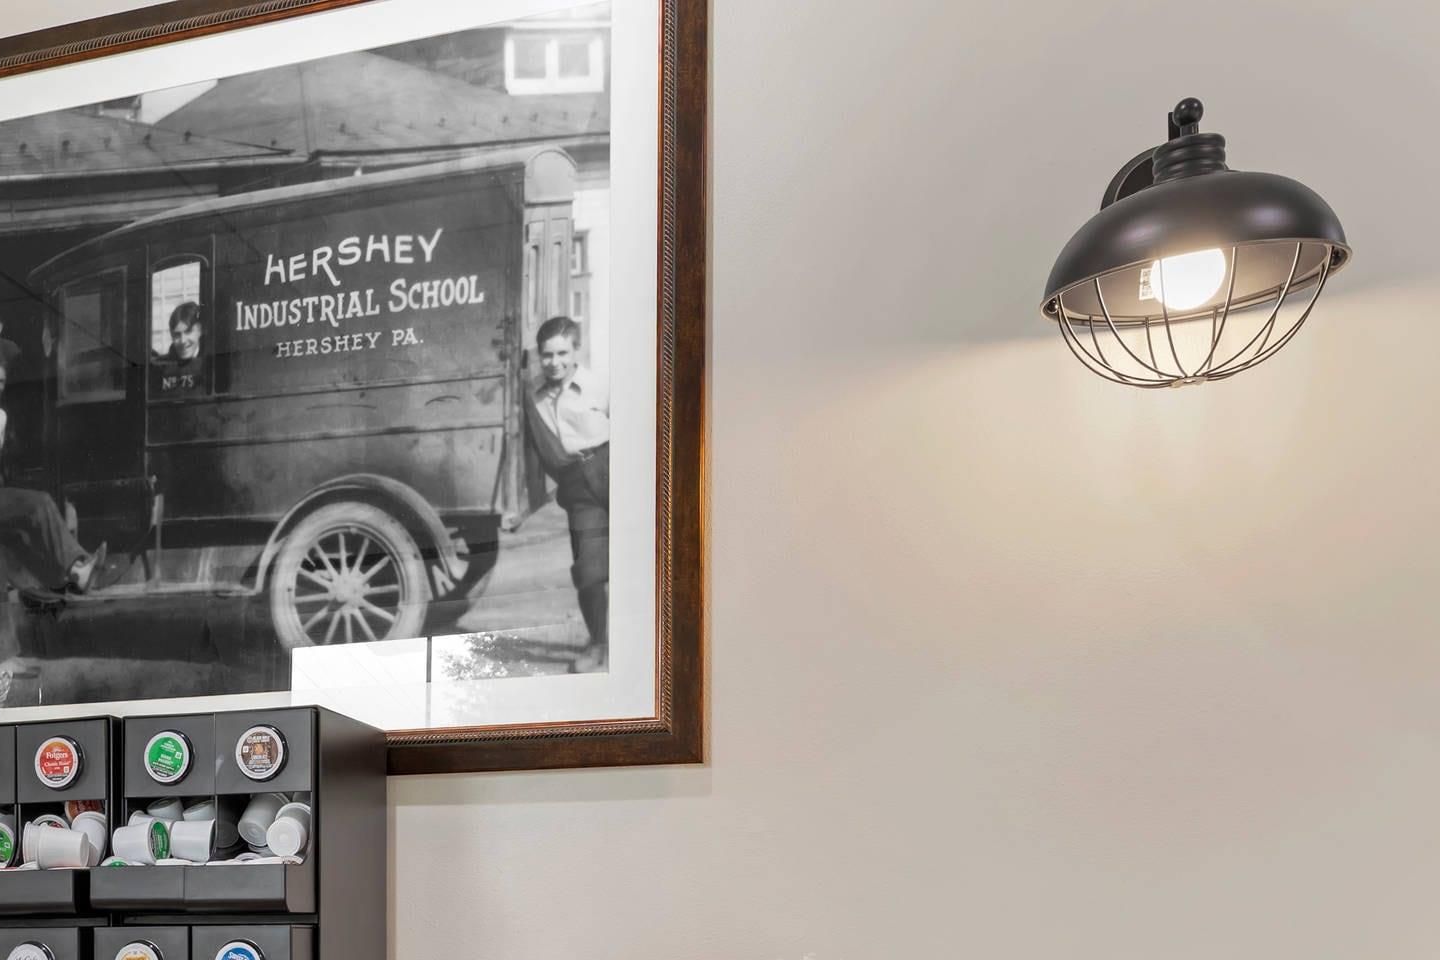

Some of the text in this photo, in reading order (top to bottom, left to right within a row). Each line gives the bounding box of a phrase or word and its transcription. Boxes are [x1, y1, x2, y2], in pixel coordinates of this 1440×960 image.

[263, 228, 444, 286] HERSHEY
[236, 275, 485, 332] INDUSTRIAL SCHOOL
[276, 328, 425, 359] HERSHEY PA.
[46, 751, 69, 761] Folgers
